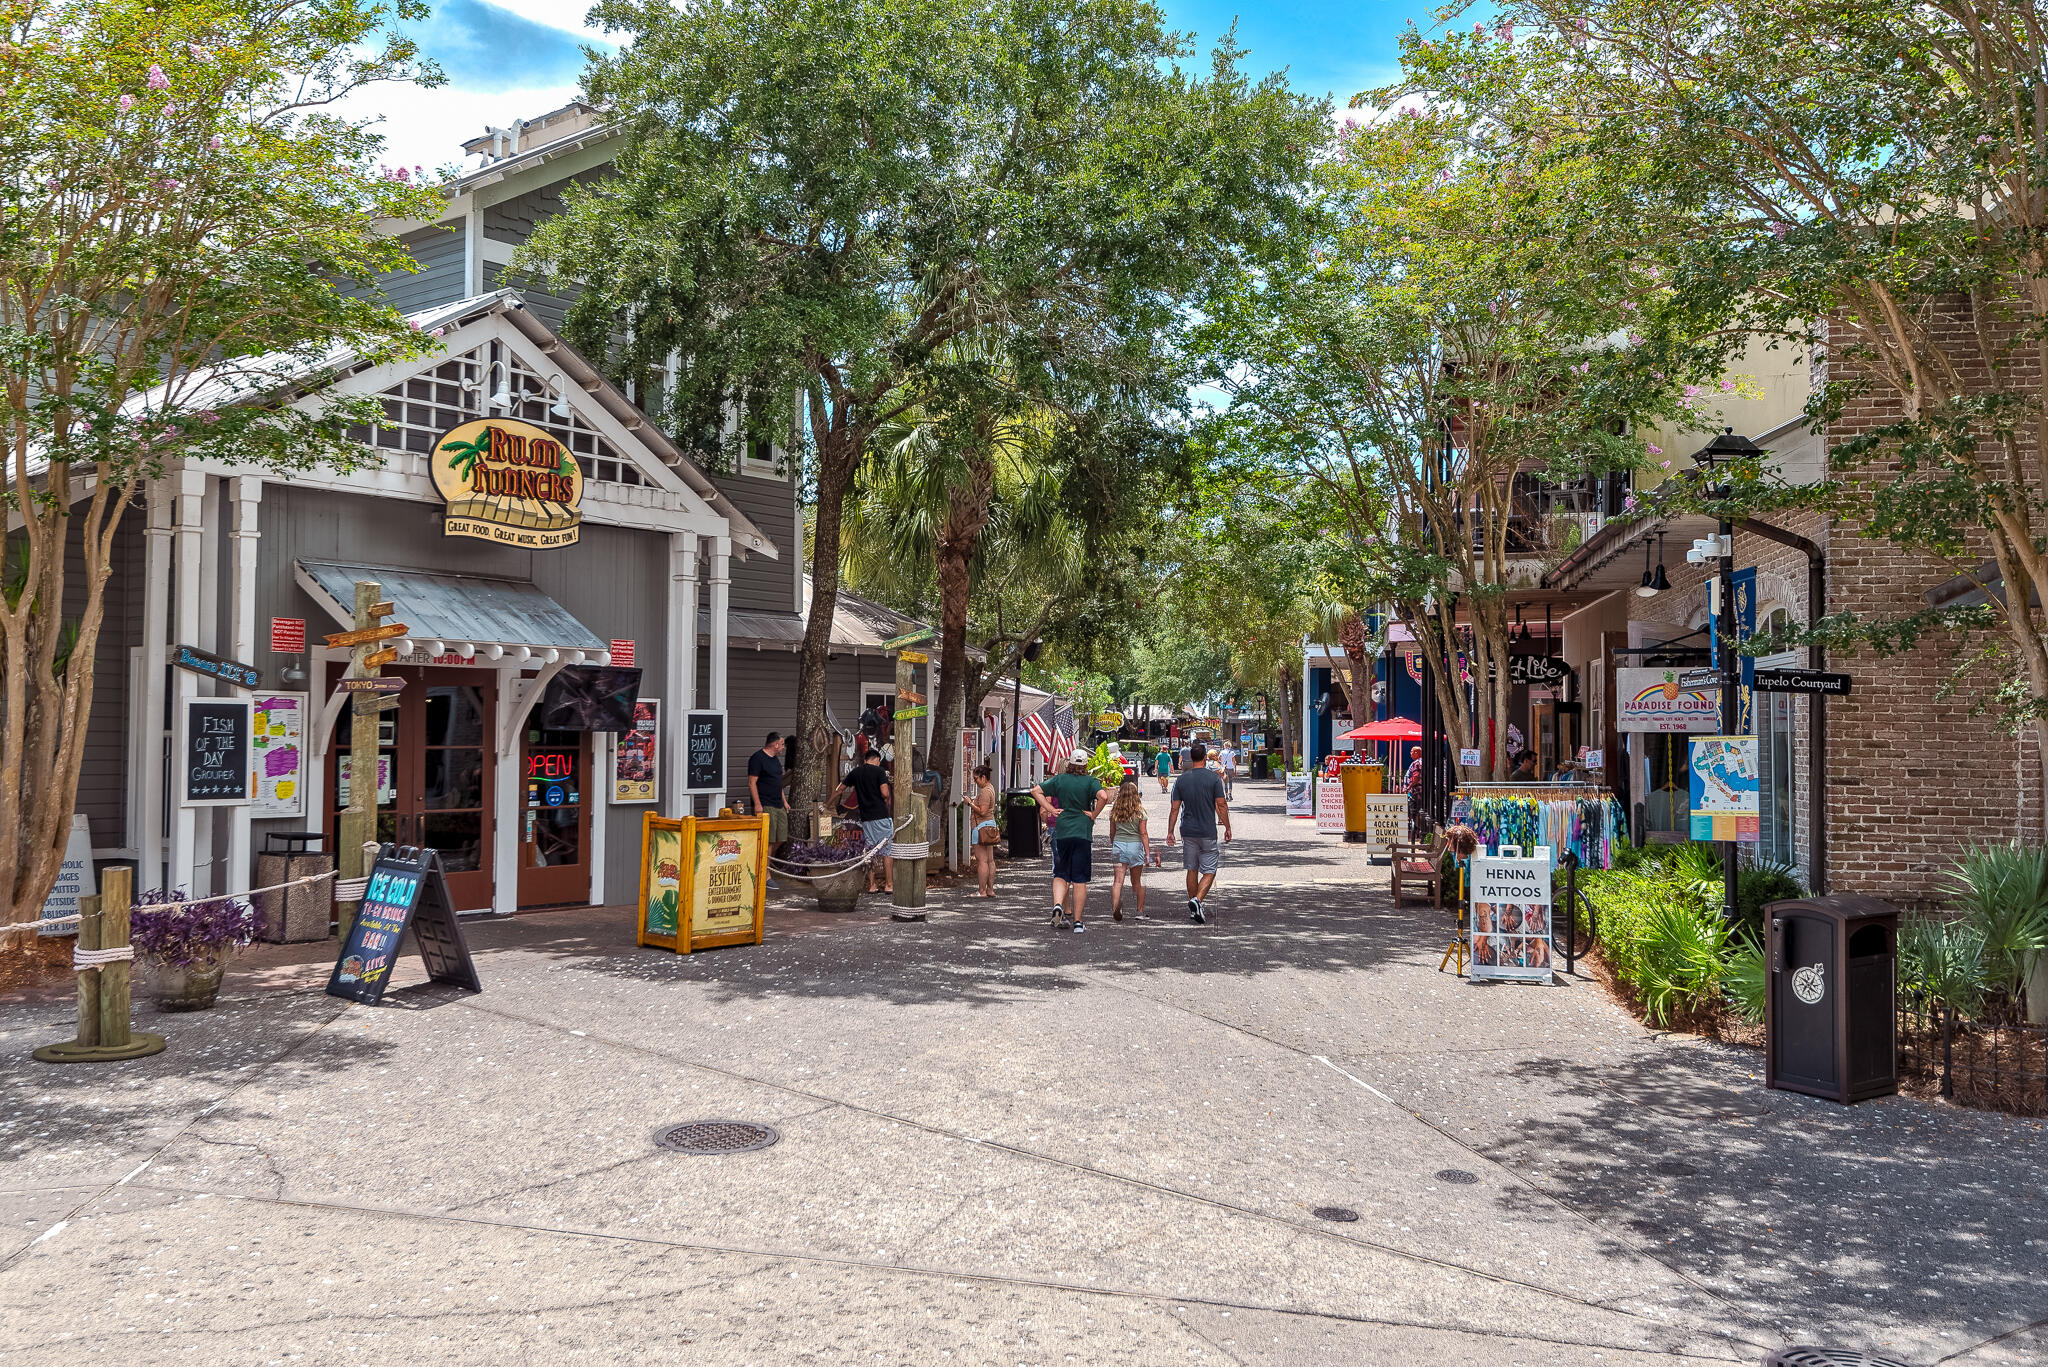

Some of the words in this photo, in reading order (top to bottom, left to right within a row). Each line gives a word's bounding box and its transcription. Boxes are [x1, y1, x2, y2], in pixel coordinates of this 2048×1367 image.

[486, 425, 562, 469] Rum
[448, 521, 470, 532] GREAT
[494, 528, 516, 542] GREAT
[540, 534, 560, 546] GREAT
[562, 530, 576, 542] FUN!
[400, 652, 430, 664] AFTER
[1527, 656, 1562, 679] Life
[346, 681, 372, 690] TOKYO
[1755, 674, 1789, 689] Tupelo
[1792, 676, 1840, 692] Courtyard
[1624, 701, 1672, 710] PARADISE
[1678, 701, 1714, 710] FOUND
[203, 716, 234, 733] FISH
[692, 724, 712, 735] LIVE
[196, 738, 210, 750] OF
[216, 736, 235, 748] THE
[691, 738, 716, 751] PIANO
[203, 751, 225, 766] DAY
[528, 754, 572, 776] OPEN
[692, 752, 714, 765] SHOW
[192, 767, 235, 780] GROUPER
[709, 872, 726, 887] BEST
[727, 871, 741, 885] LIVE
[1486, 869, 1536, 880] HENNA
[51, 885, 80, 893] MITTED
[366, 872, 391, 902] ICE
[386, 876, 417, 907] COLD
[708, 885, 742, 896] ENTERTAINMENT
[1480, 886, 1541, 897] TATTOOS
[712, 895, 726, 904] DINNER
[381, 906, 407, 922] DRINKS
[361, 930, 388, 951] BAR!!
[365, 954, 387, 971] LIVE
